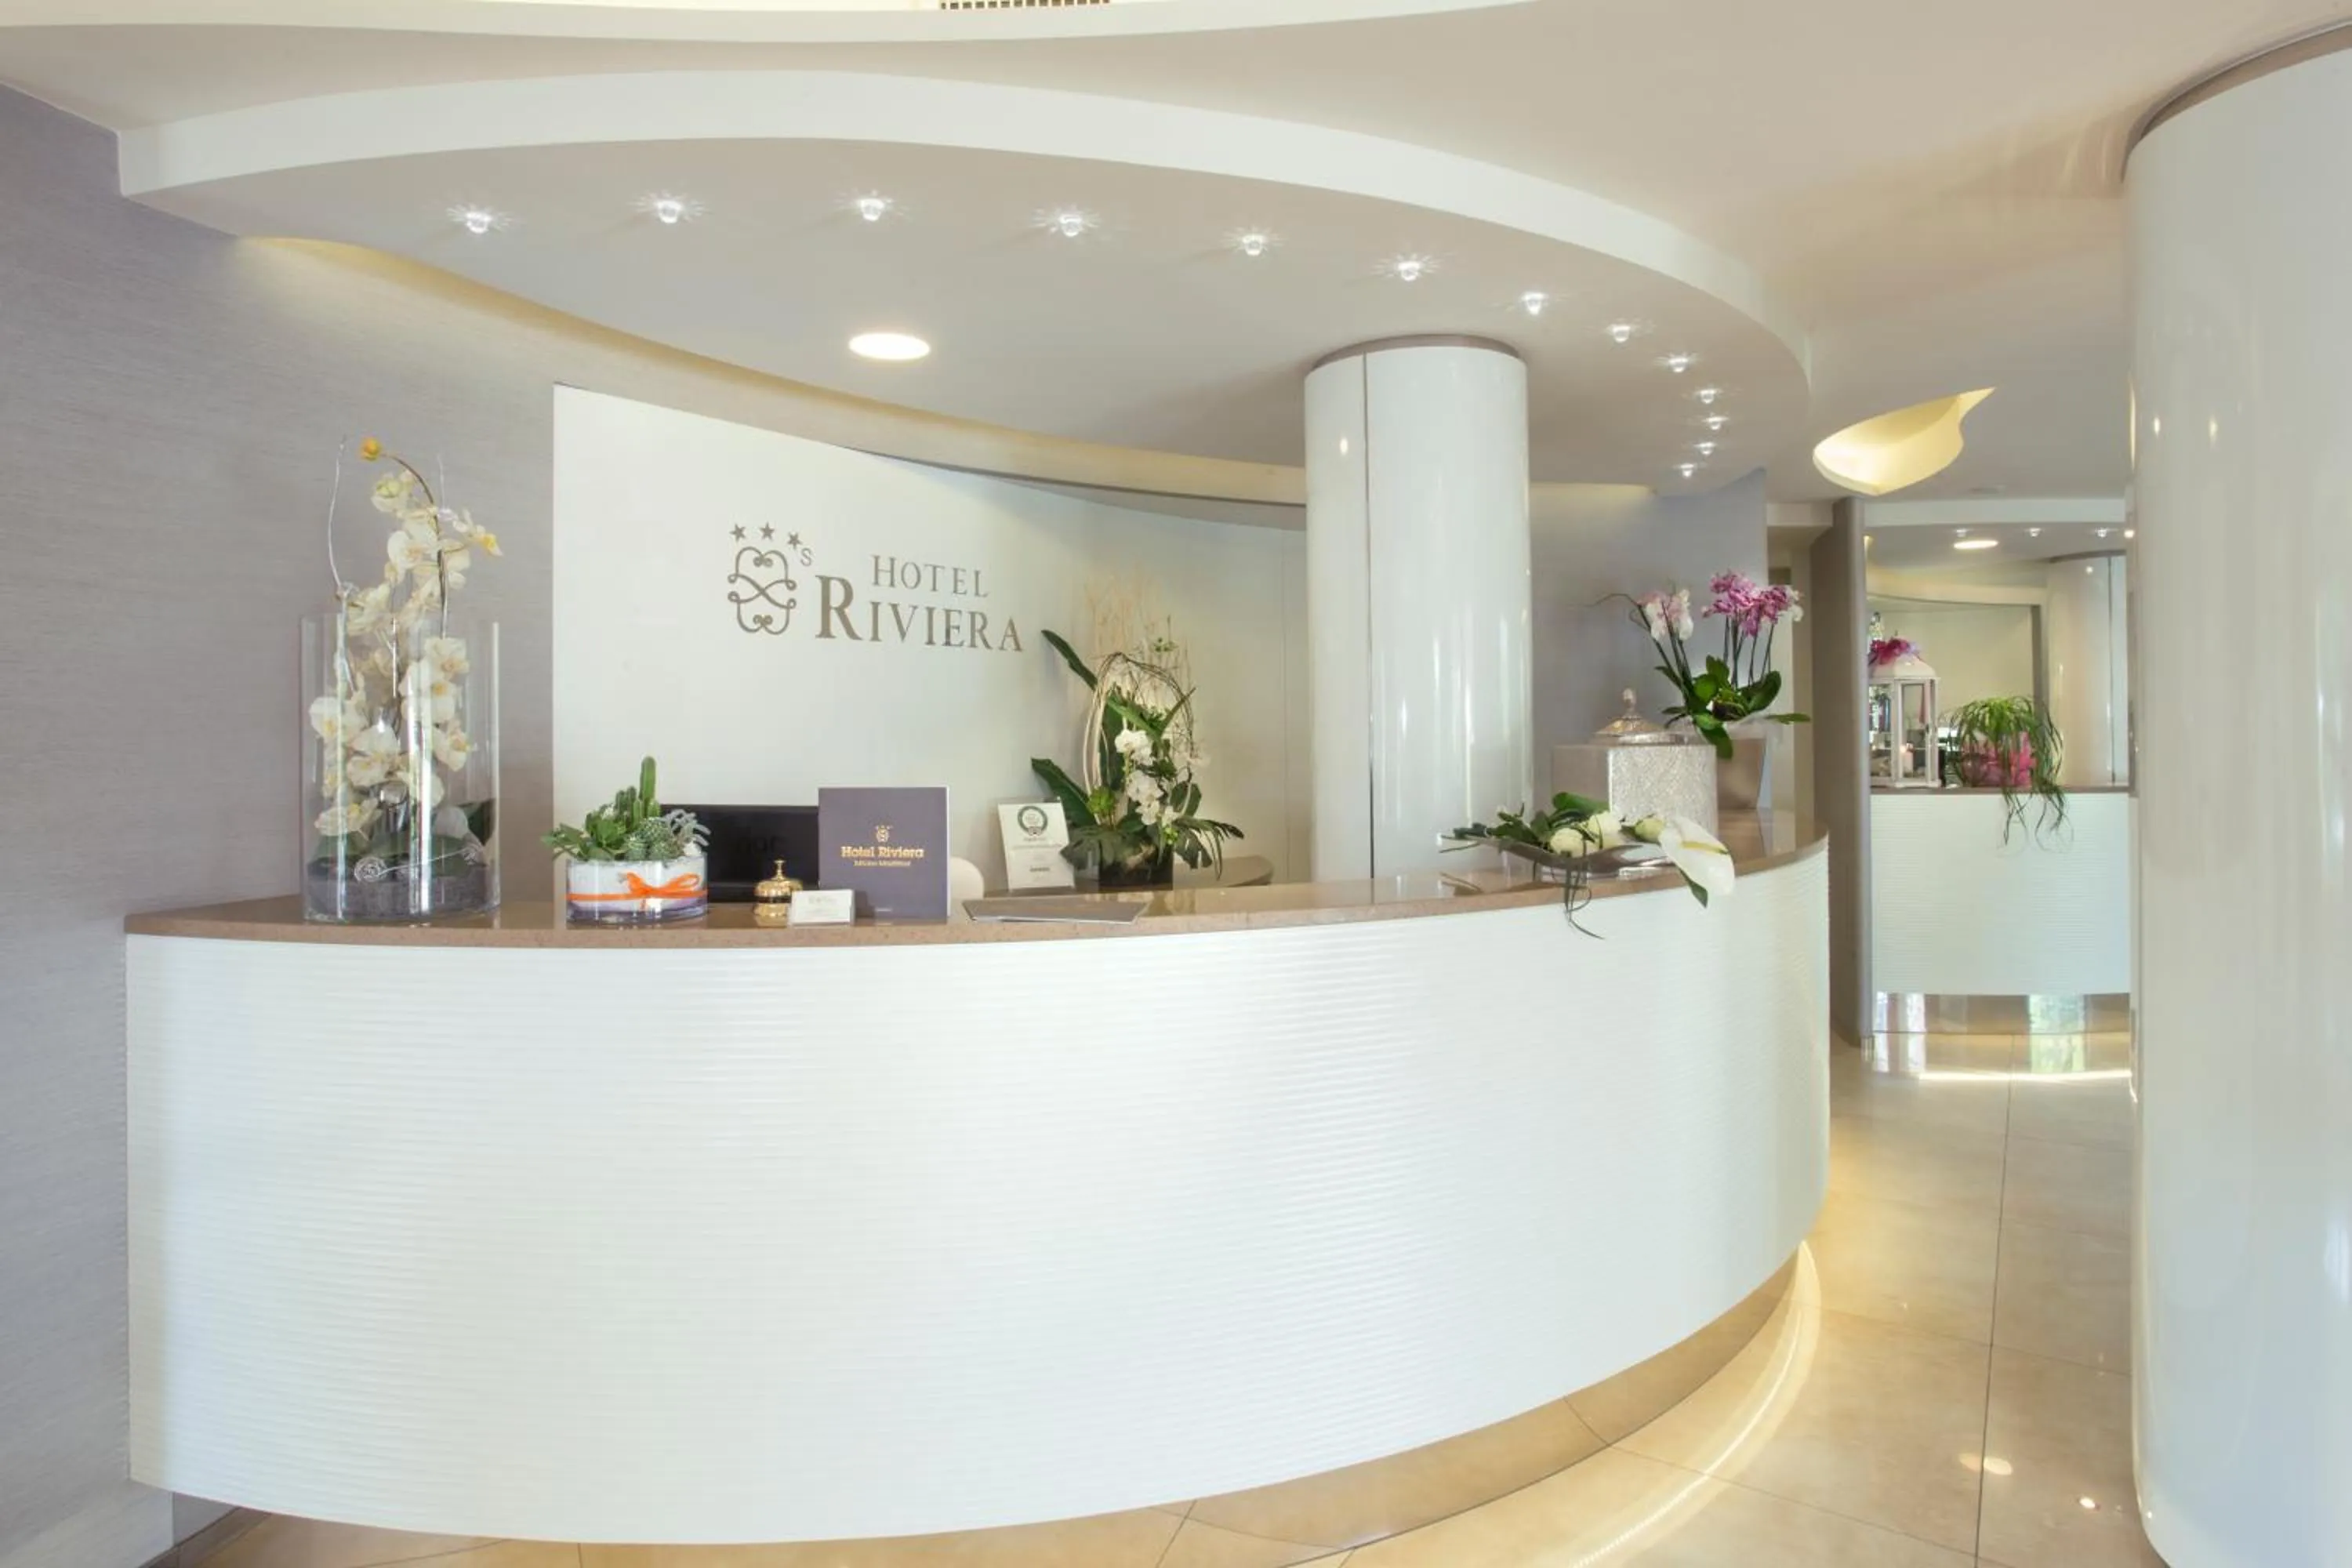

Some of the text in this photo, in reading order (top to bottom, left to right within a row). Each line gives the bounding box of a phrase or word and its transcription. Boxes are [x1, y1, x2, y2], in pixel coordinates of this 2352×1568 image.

[800, 547, 812, 567] S
[871, 554, 989, 598] HOTEL
[815, 574, 1024, 652] RIVIERA
[840, 846, 924, 858] Hotel Riviera
